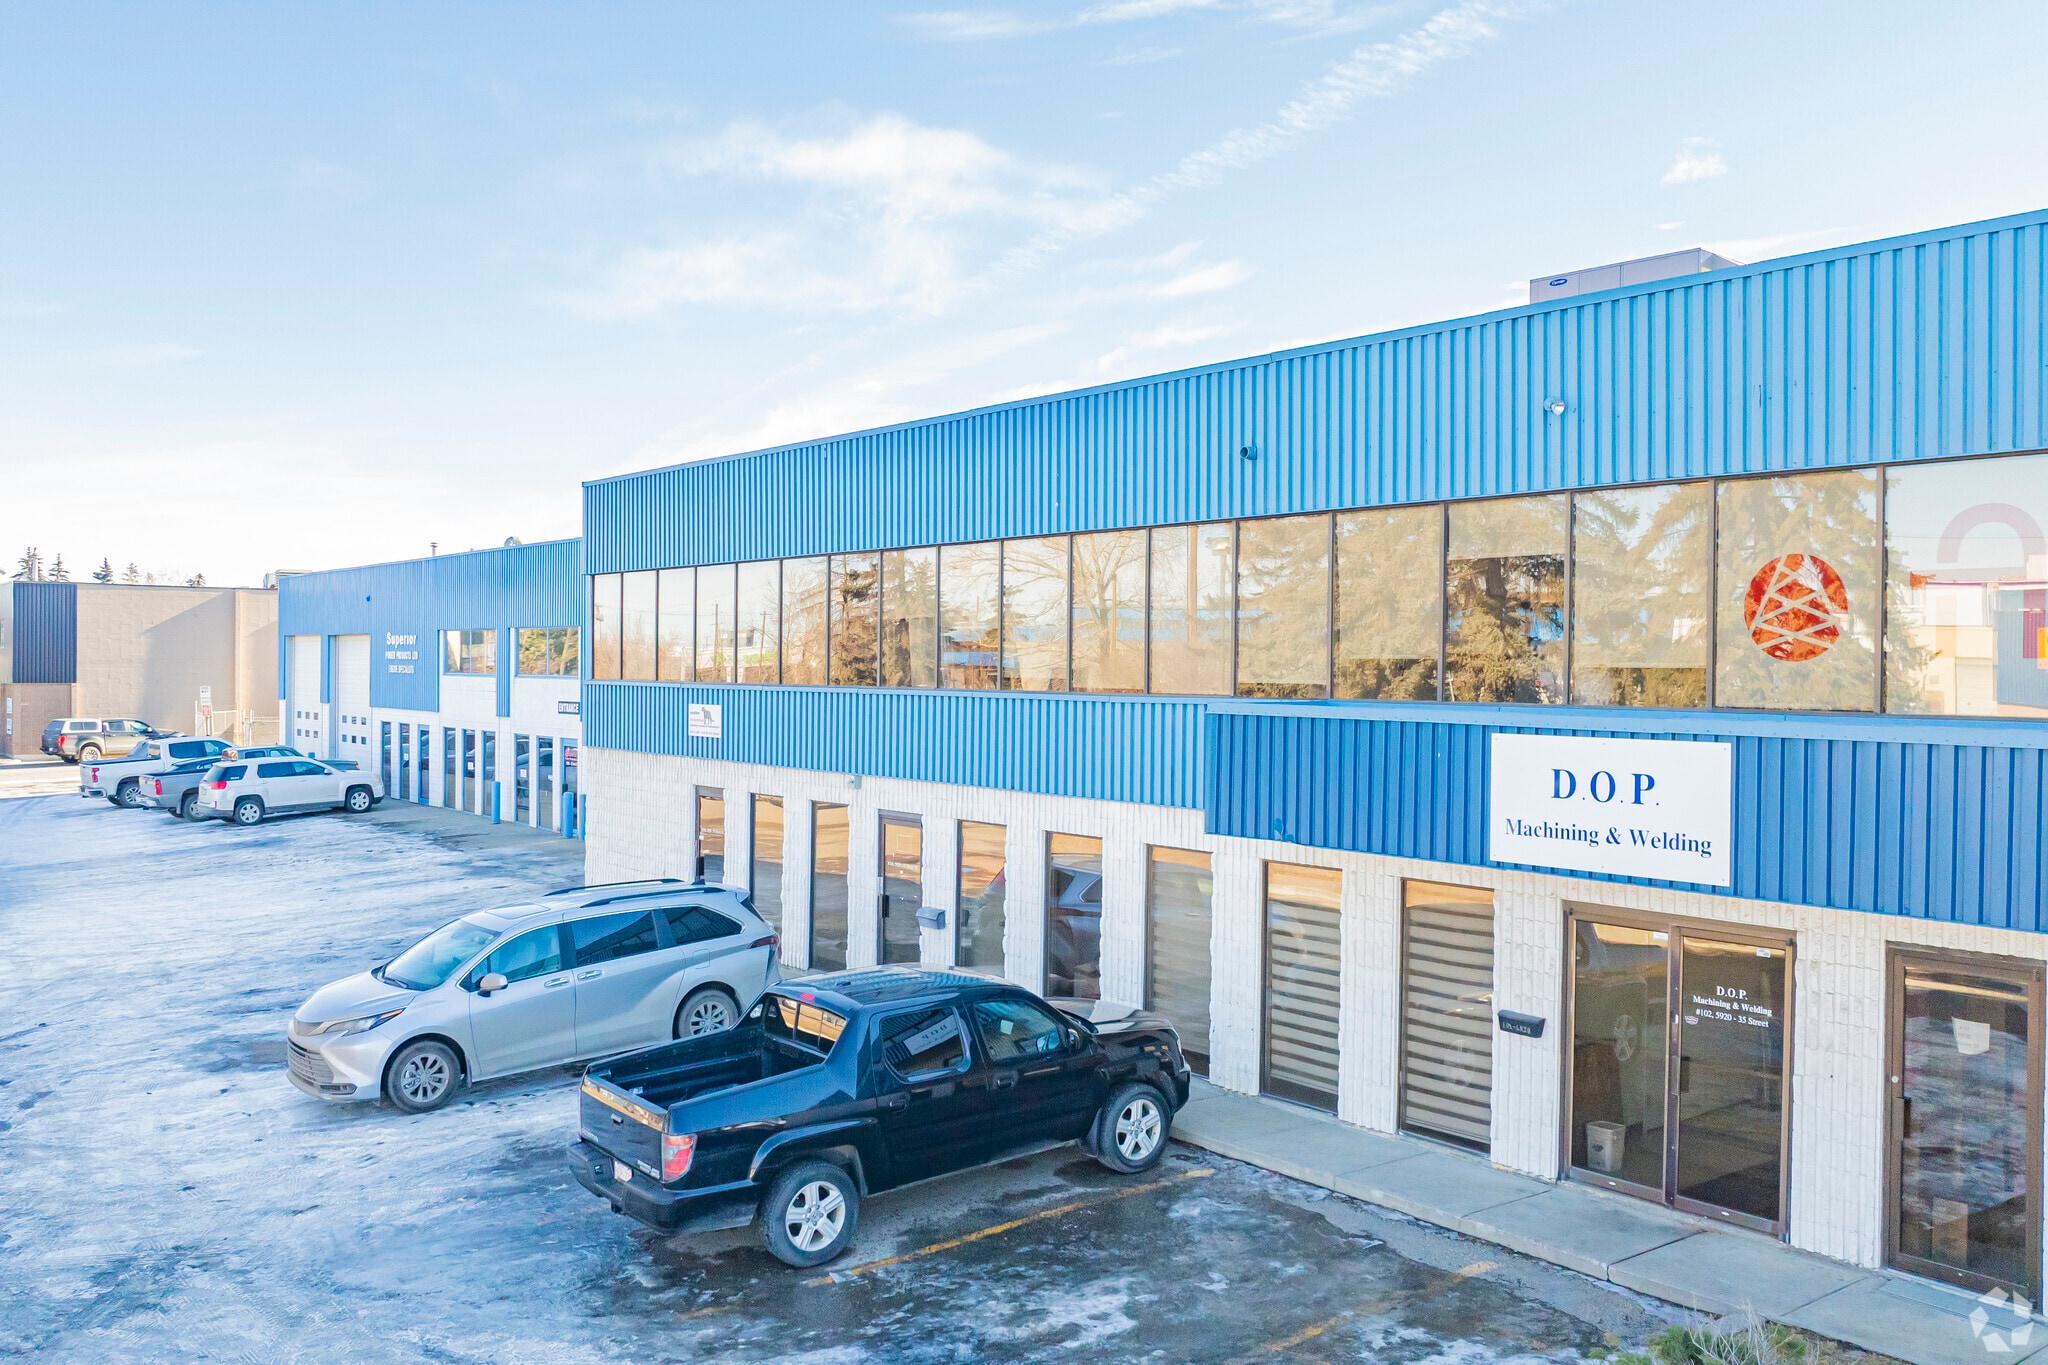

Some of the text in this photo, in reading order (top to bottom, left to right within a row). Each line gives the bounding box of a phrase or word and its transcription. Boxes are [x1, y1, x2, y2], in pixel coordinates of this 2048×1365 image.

[386, 631, 416, 648] Superior
[1550, 768, 1660, 806] D.O.P.
[1505, 818, 1712, 858] Machining & Welding
[1716, 985, 1748, 1000] D.O.P.
[1692, 995, 1773, 1017] Machining & Welding
[1695, 1008, 1714, 1019] #102,
[1715, 1011, 1732, 1021] 5920
[1738, 1015, 1747, 1024] 35
[1748, 1017, 1769, 1028] Street
